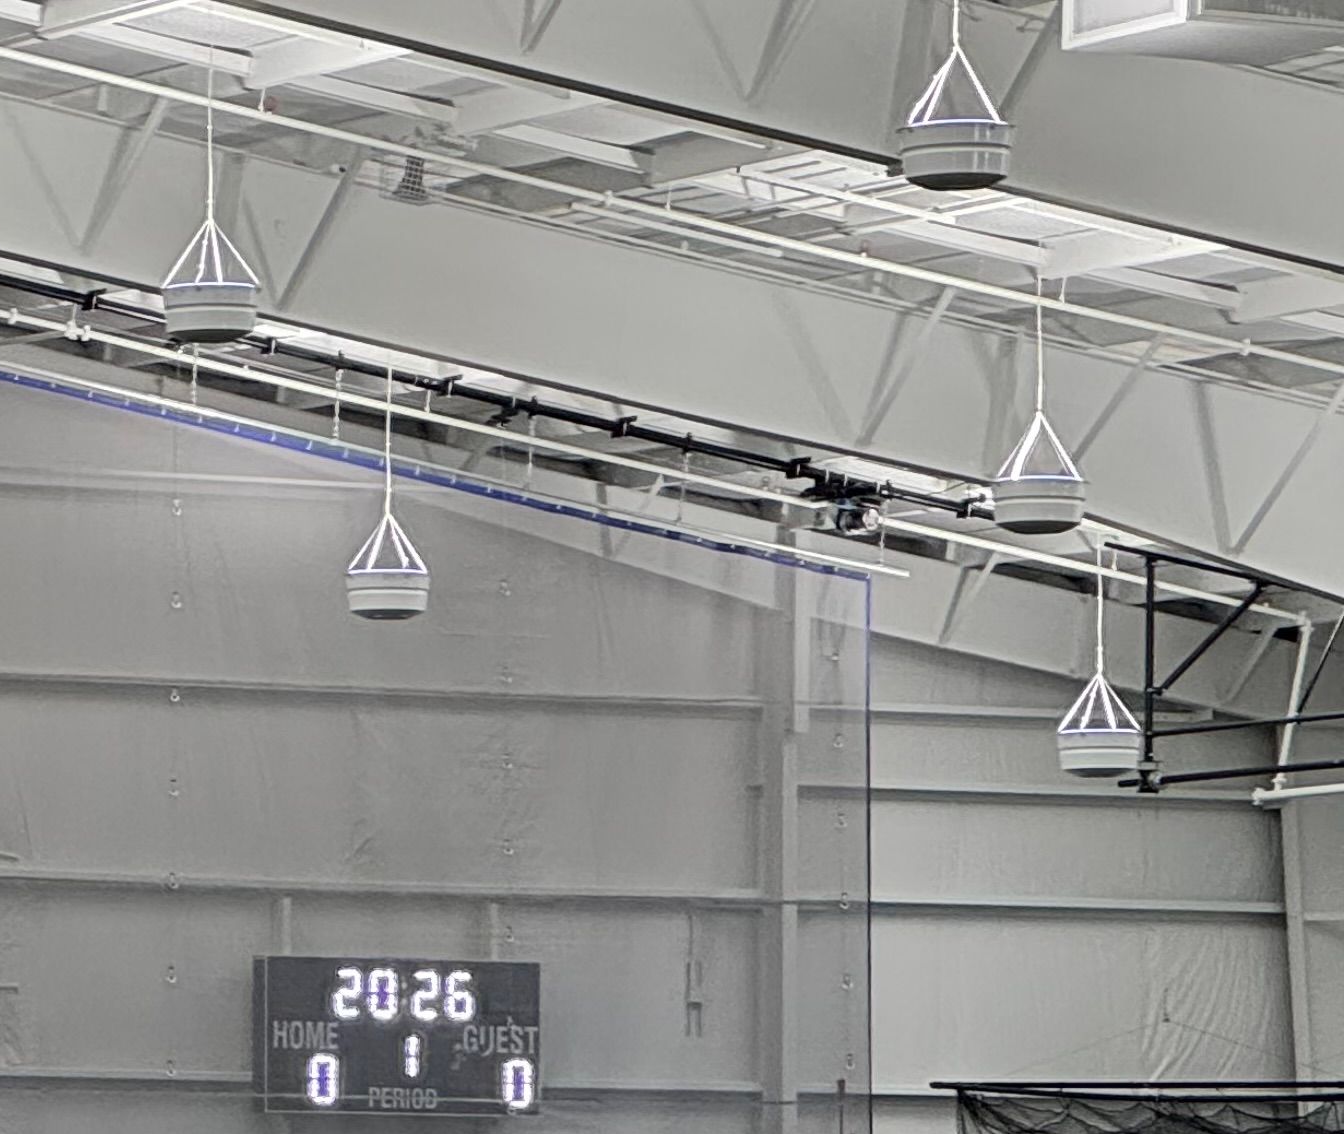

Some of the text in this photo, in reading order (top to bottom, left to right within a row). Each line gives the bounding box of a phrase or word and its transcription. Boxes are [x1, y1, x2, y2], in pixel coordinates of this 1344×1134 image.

[273, 1020, 339, 1049] HOME
[463, 1025, 539, 1057] GUEST
[404, 1034, 421, 1078] 1
[307, 1052, 340, 1105] 0
[368, 1086, 438, 1109] PERIOD
[502, 1058, 534, 1110] 0
